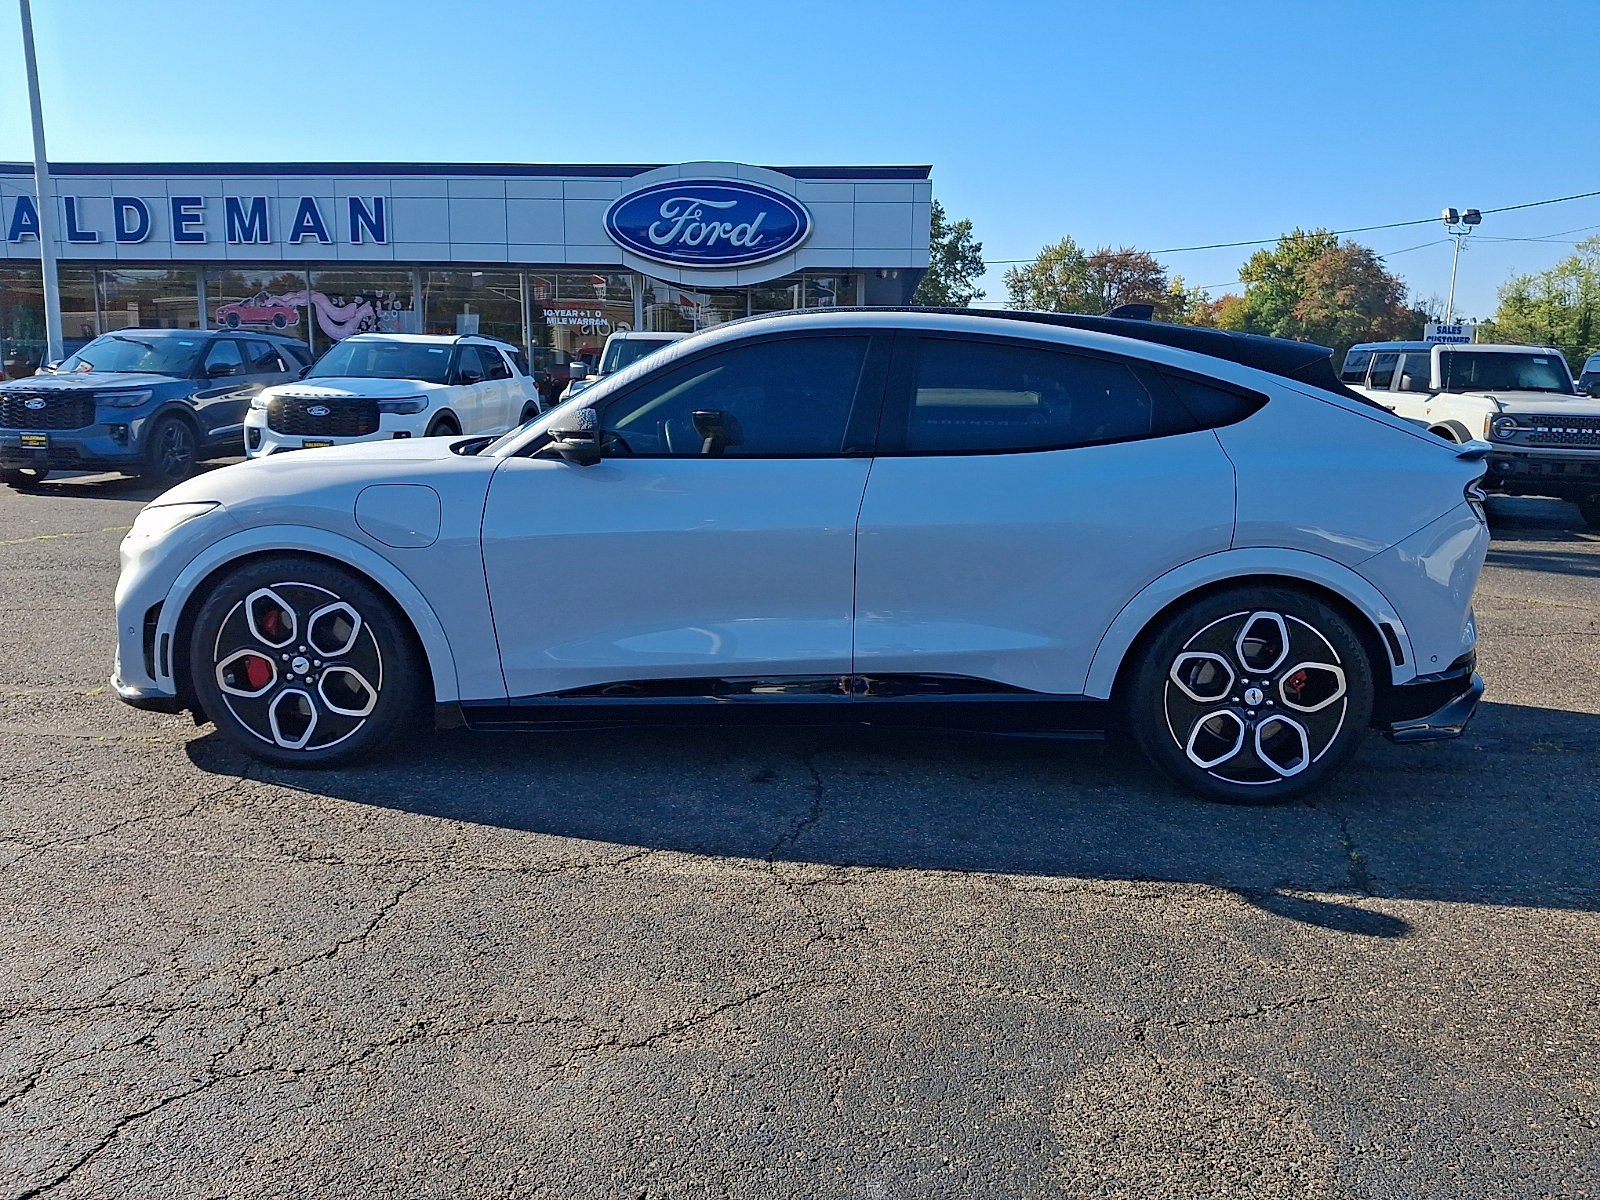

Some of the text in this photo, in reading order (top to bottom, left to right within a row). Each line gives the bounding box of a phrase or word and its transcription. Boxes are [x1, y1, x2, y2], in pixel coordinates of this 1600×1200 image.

[649, 197, 767, 247] Ford
[546, 317, 568, 325] MILE
[1436, 325, 1462, 335] SALES
[1426, 335, 1471, 344] CUSTOMER
